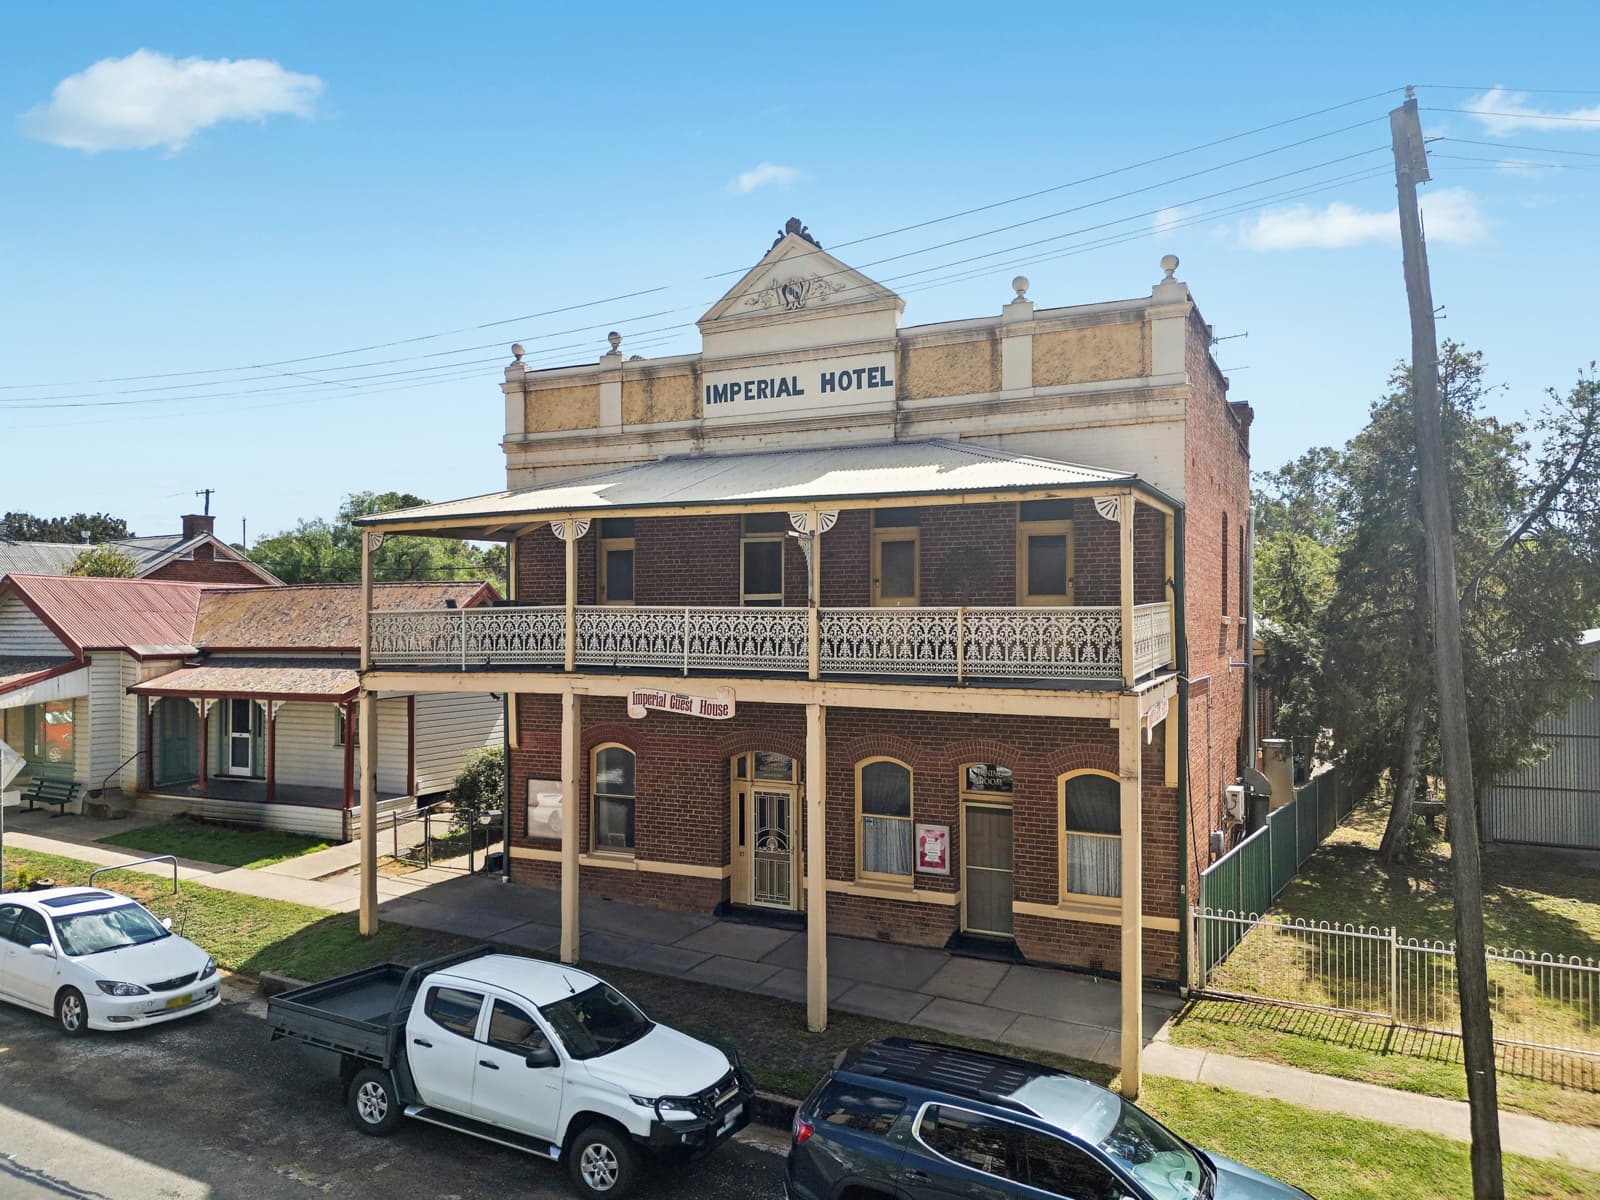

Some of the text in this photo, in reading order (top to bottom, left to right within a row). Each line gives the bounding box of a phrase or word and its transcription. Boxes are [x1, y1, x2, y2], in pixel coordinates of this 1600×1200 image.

[706, 366, 893, 404] IMPERIAL HOTEL
[632, 691, 729, 716] Imperial Guest House
